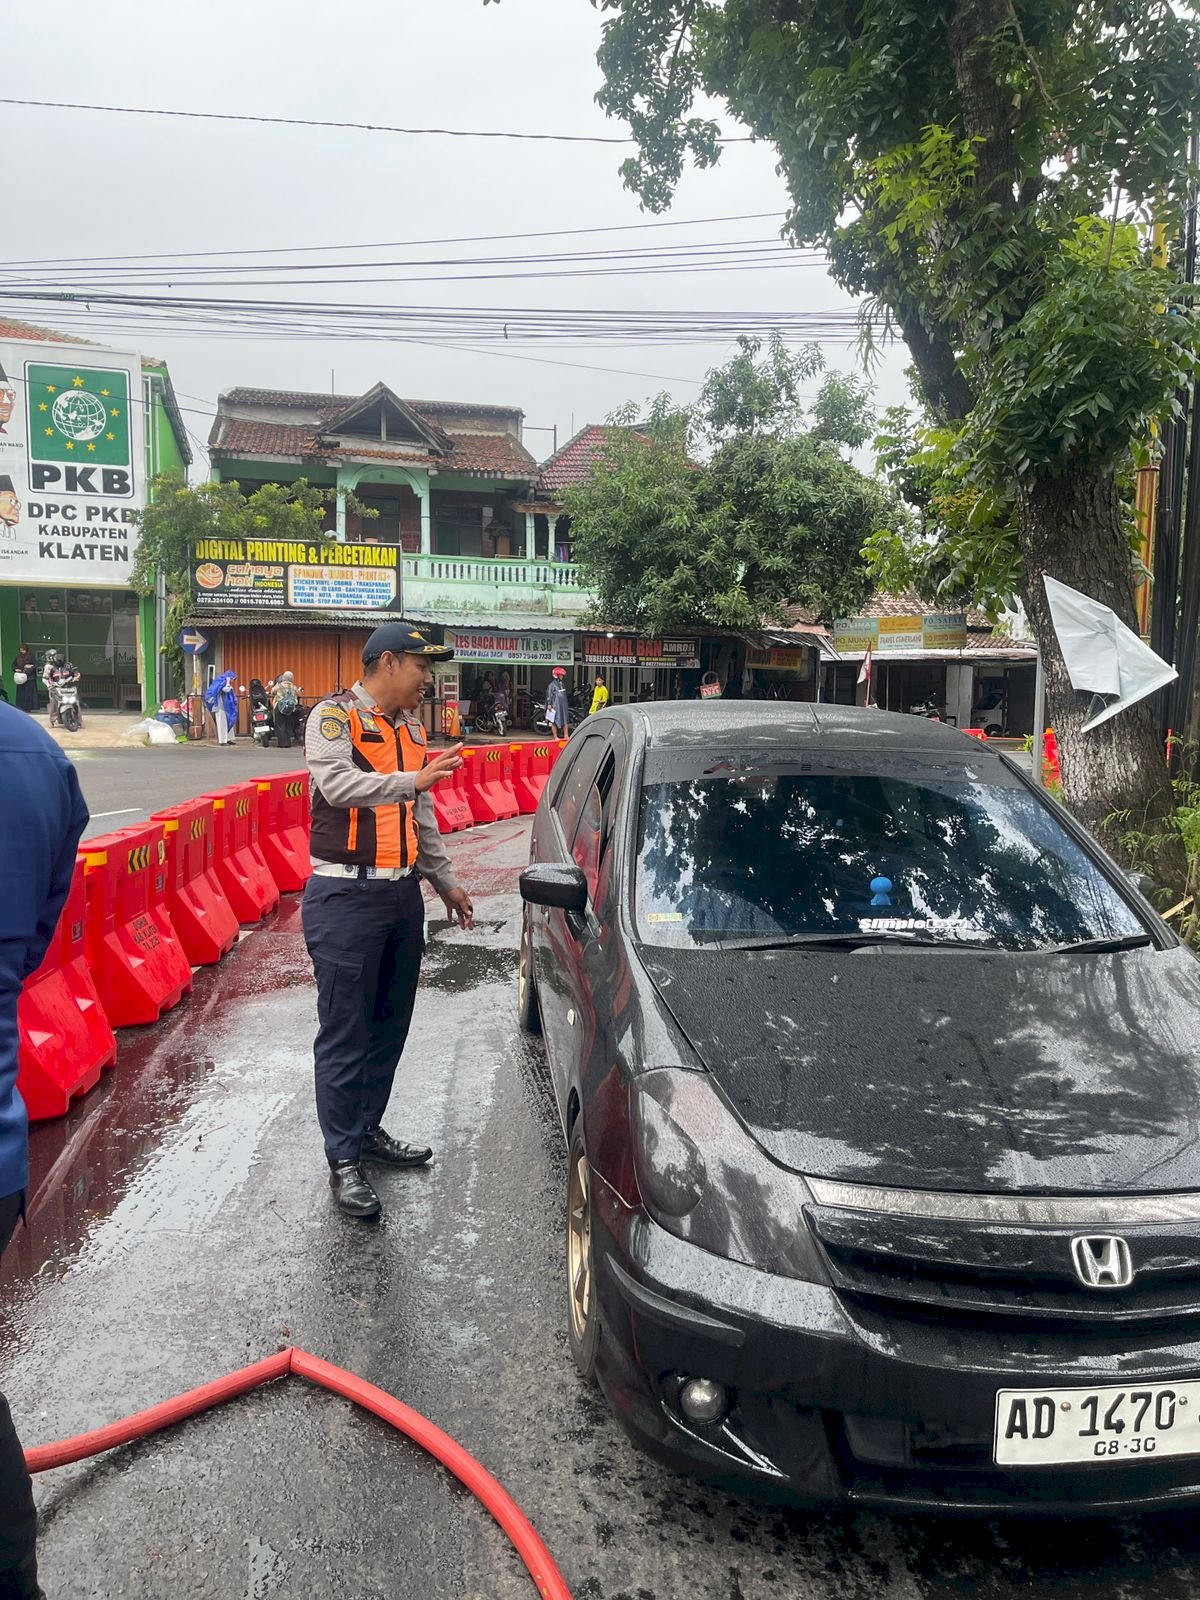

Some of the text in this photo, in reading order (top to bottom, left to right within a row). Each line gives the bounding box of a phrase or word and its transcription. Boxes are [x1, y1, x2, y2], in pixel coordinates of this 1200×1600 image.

[31, 464, 131, 495] PKB
[27, 502, 78, 520] DPC
[38, 524, 128, 540] KABUPATEN
[38, 541, 129, 562] KLATEN
[196, 539, 397, 567] DIGITAL PRINTING & PERCETAKAN
[227, 563, 284, 578] cahaya
[456, 635, 470, 648] LES
[471, 636, 494, 650] BACA
[496, 637, 520, 650] KILAT
[520, 638, 532, 651] TK
[533, 639, 540, 651] &
[540, 639, 552, 652] SD
[583, 637, 663, 656] TAMBAL BAN
[585, 654, 613, 664] TUBELESS
[613, 655, 618, 664] &
[618, 655, 637, 664] PREES
[1005, 1389, 1176, 1439] AD 1470
